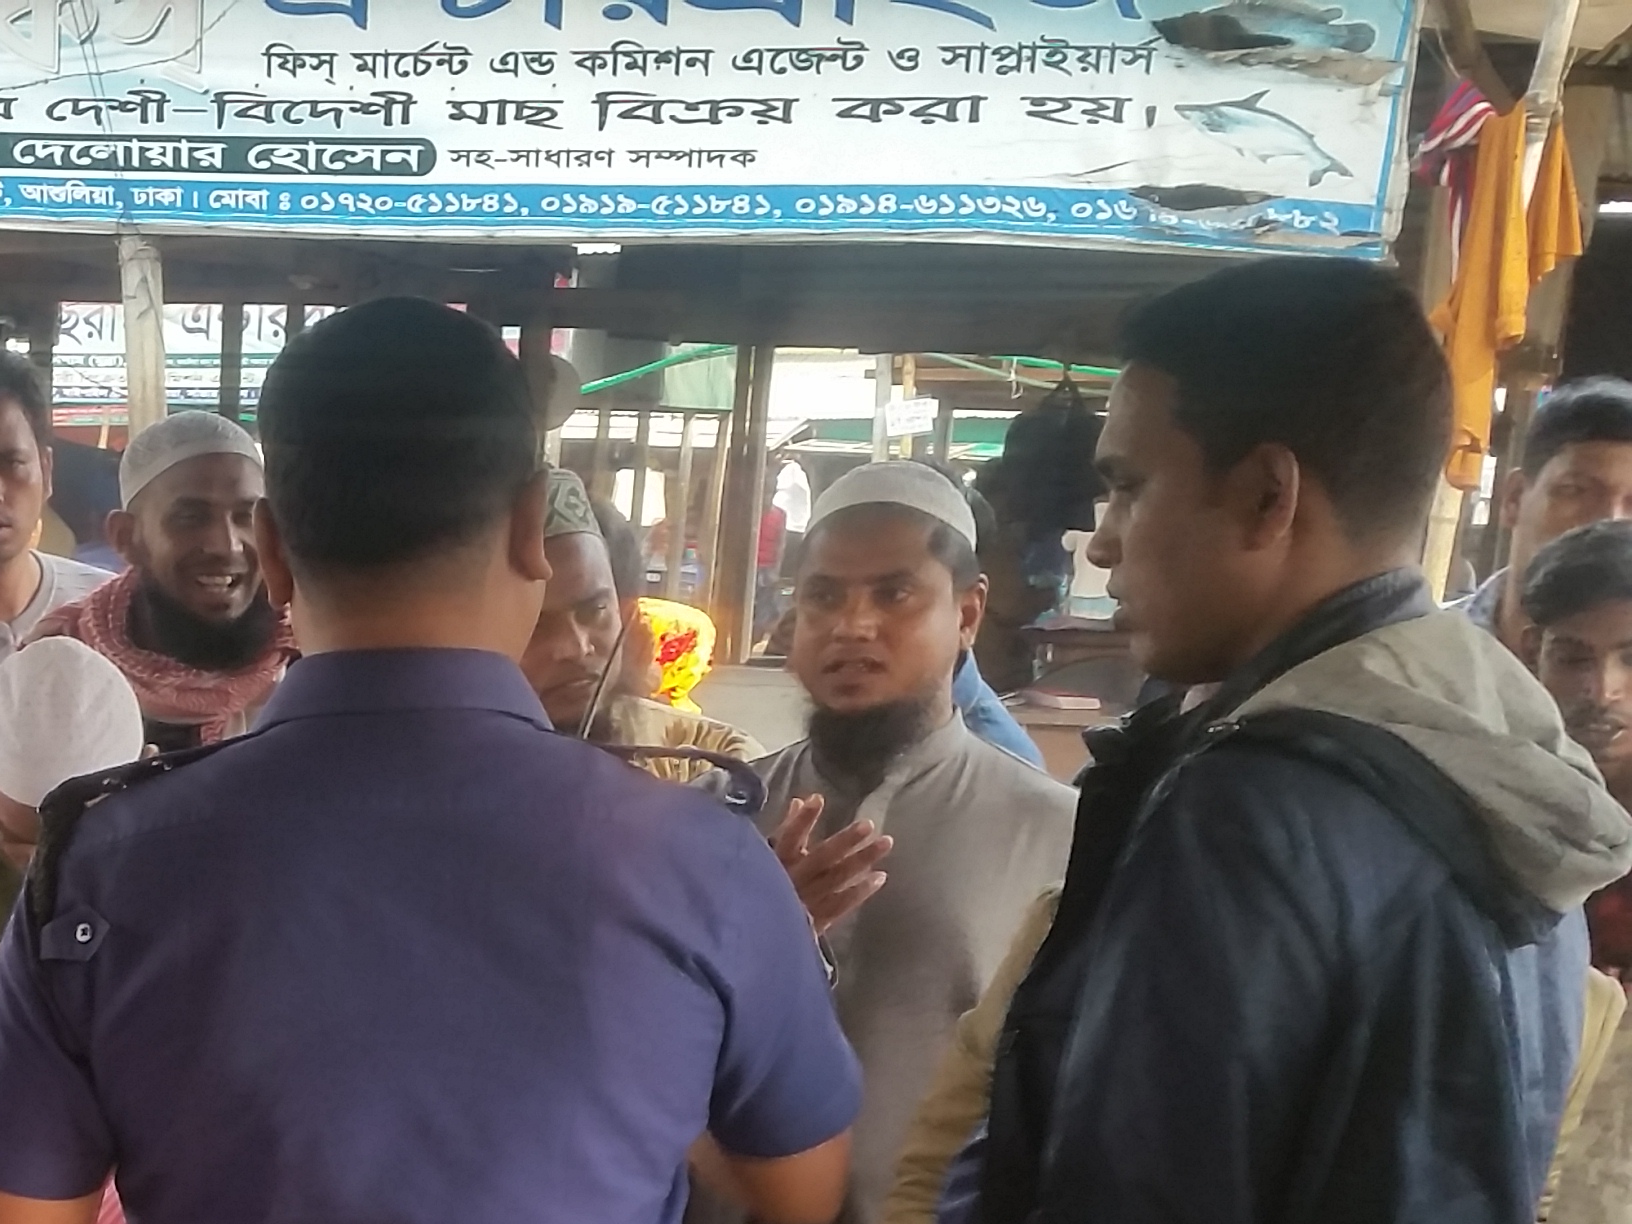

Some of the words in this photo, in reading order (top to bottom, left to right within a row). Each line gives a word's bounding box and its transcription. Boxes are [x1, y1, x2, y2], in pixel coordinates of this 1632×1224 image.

[261, 42, 338, 85] ফিস্
[349, 40, 473, 79] মার্চেন্ট
[569, 39, 716, 77] কমিশন
[731, 36, 870, 76] এজেন্ট
[886, 47, 921, 73] ও
[446, 98, 565, 130] মাছ
[591, 90, 800, 132] বিক্রয়
[831, 95, 989, 124] করা
[12, 138, 228, 171] দেলোয়ার
[247, 140, 426, 174] হোসেন
[447, 147, 616, 170] সহ-সাধারণ
[625, 147, 759, 169] সম্পাদক
